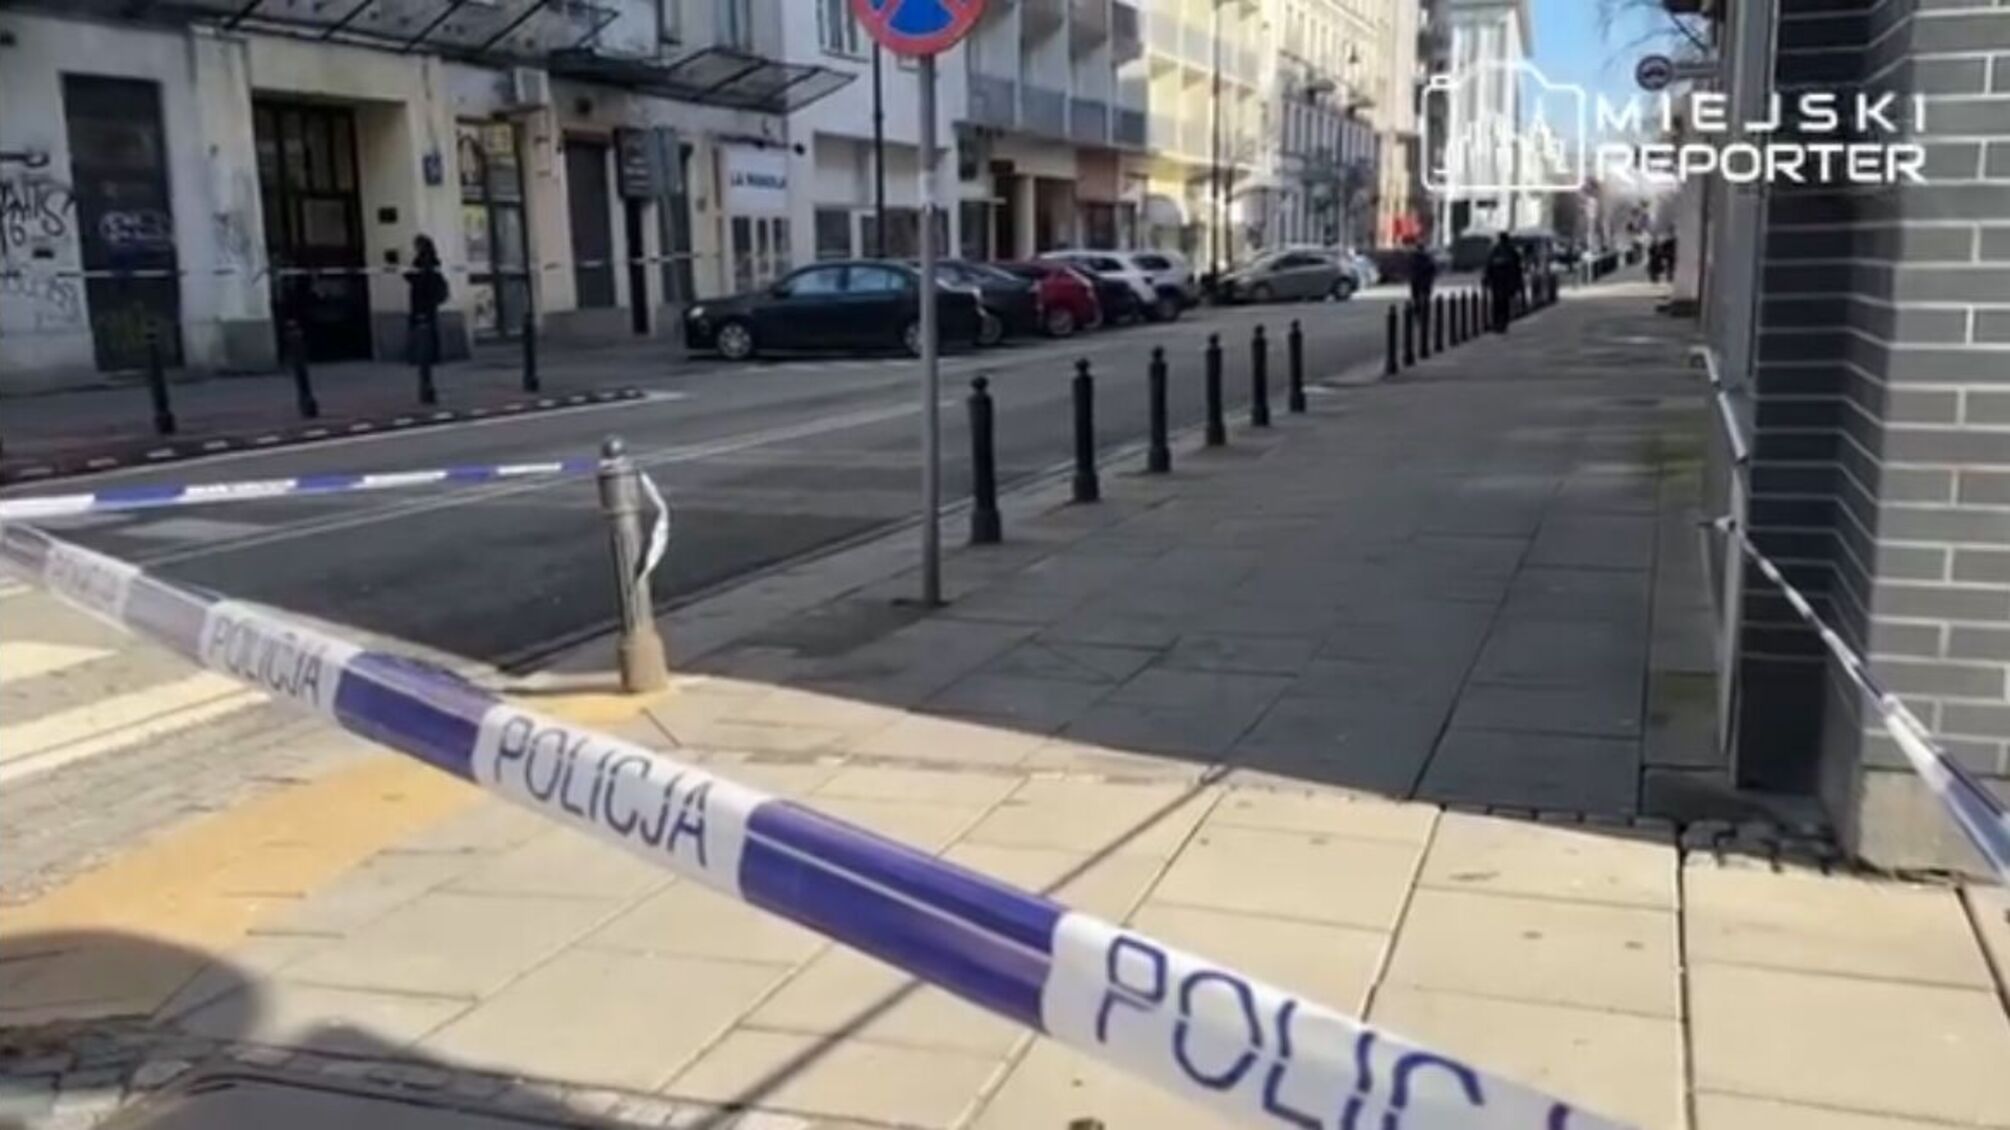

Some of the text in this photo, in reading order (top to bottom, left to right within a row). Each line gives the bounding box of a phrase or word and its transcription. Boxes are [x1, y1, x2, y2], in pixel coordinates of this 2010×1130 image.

[208, 615, 327, 707] POLICJA
[494, 714, 714, 868] POLICJA
[1098, 936, 1571, 1130] POLIC
